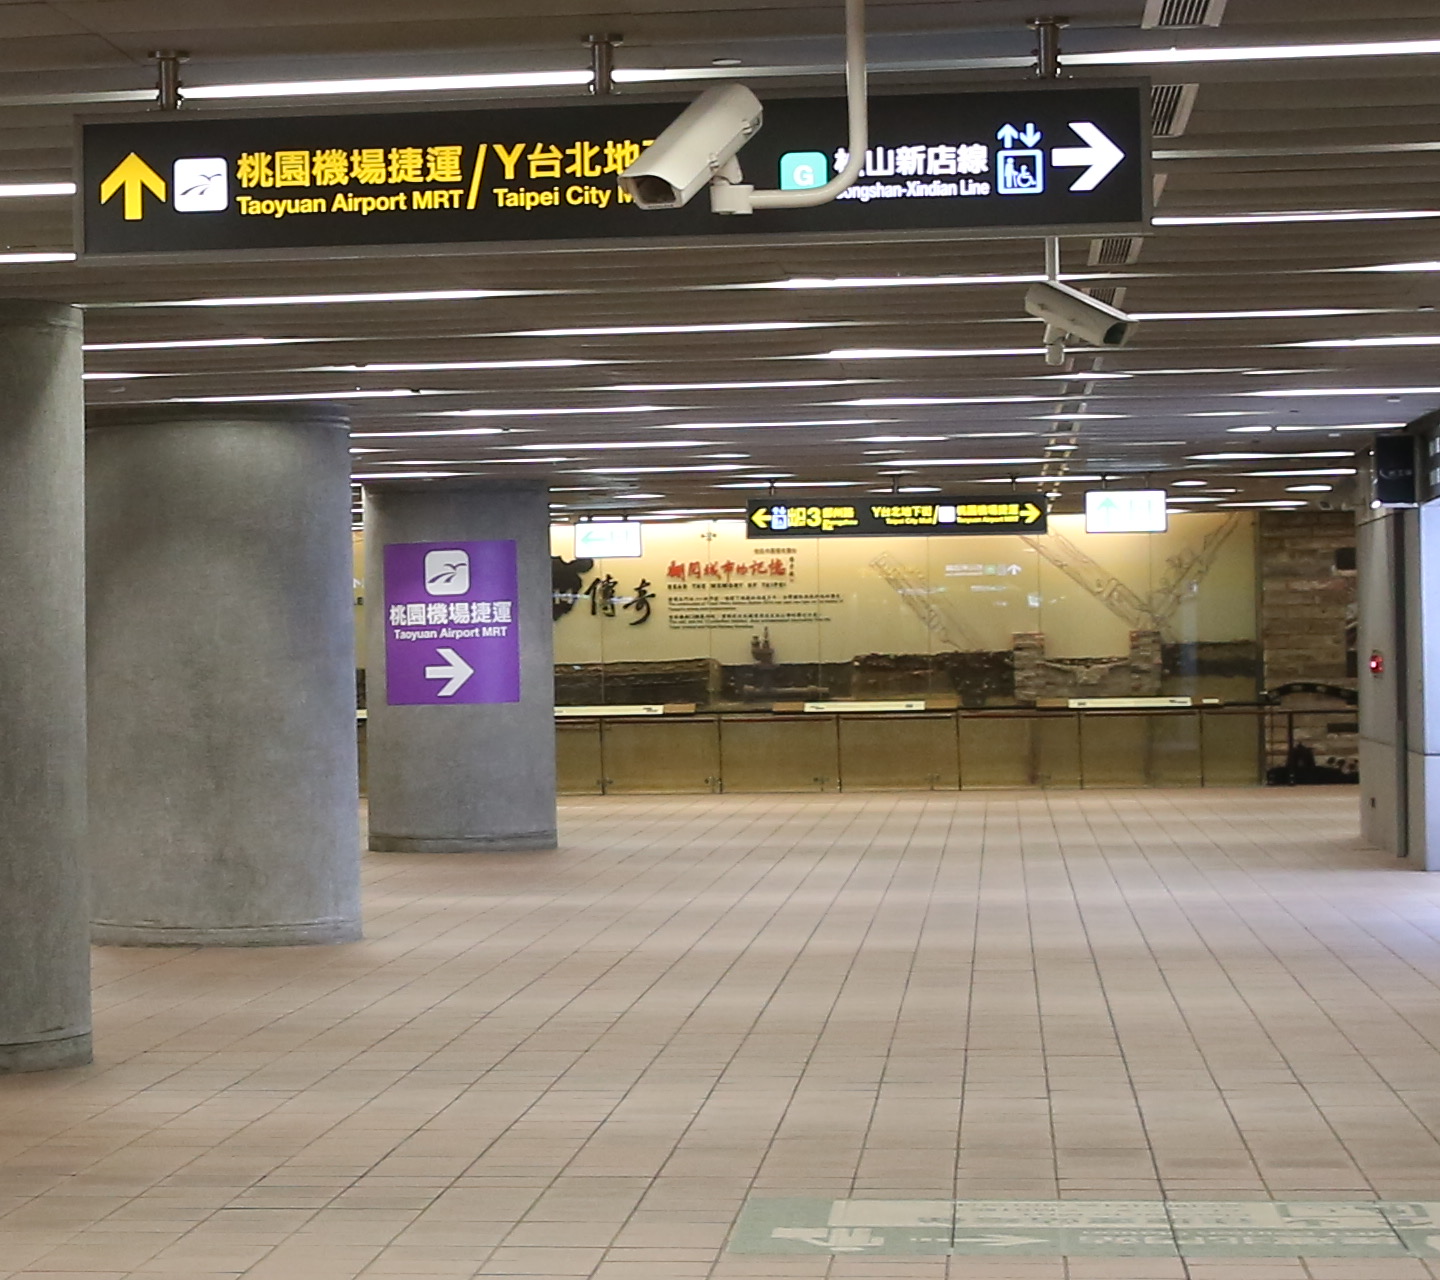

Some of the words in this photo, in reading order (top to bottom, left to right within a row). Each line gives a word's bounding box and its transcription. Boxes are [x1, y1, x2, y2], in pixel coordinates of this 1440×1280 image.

[236, 145, 463, 188] 桃園機場捷運
[493, 139, 657, 180] Y台北地
[793, 164, 815, 187] G
[493, 185, 560, 208] Taipei
[566, 184, 611, 209] City
[960, 179, 990, 196] Line
[236, 195, 329, 218] Taoyuan
[330, 192, 408, 216] Airport
[412, 189, 464, 210] MRT
[806, 507, 821, 527] 3
[389, 601, 512, 626] 桃園機場捷運
[393, 629, 438, 641] Taoyuan
[439, 627, 480, 640] Airport
[482, 626, 508, 637] MRT
